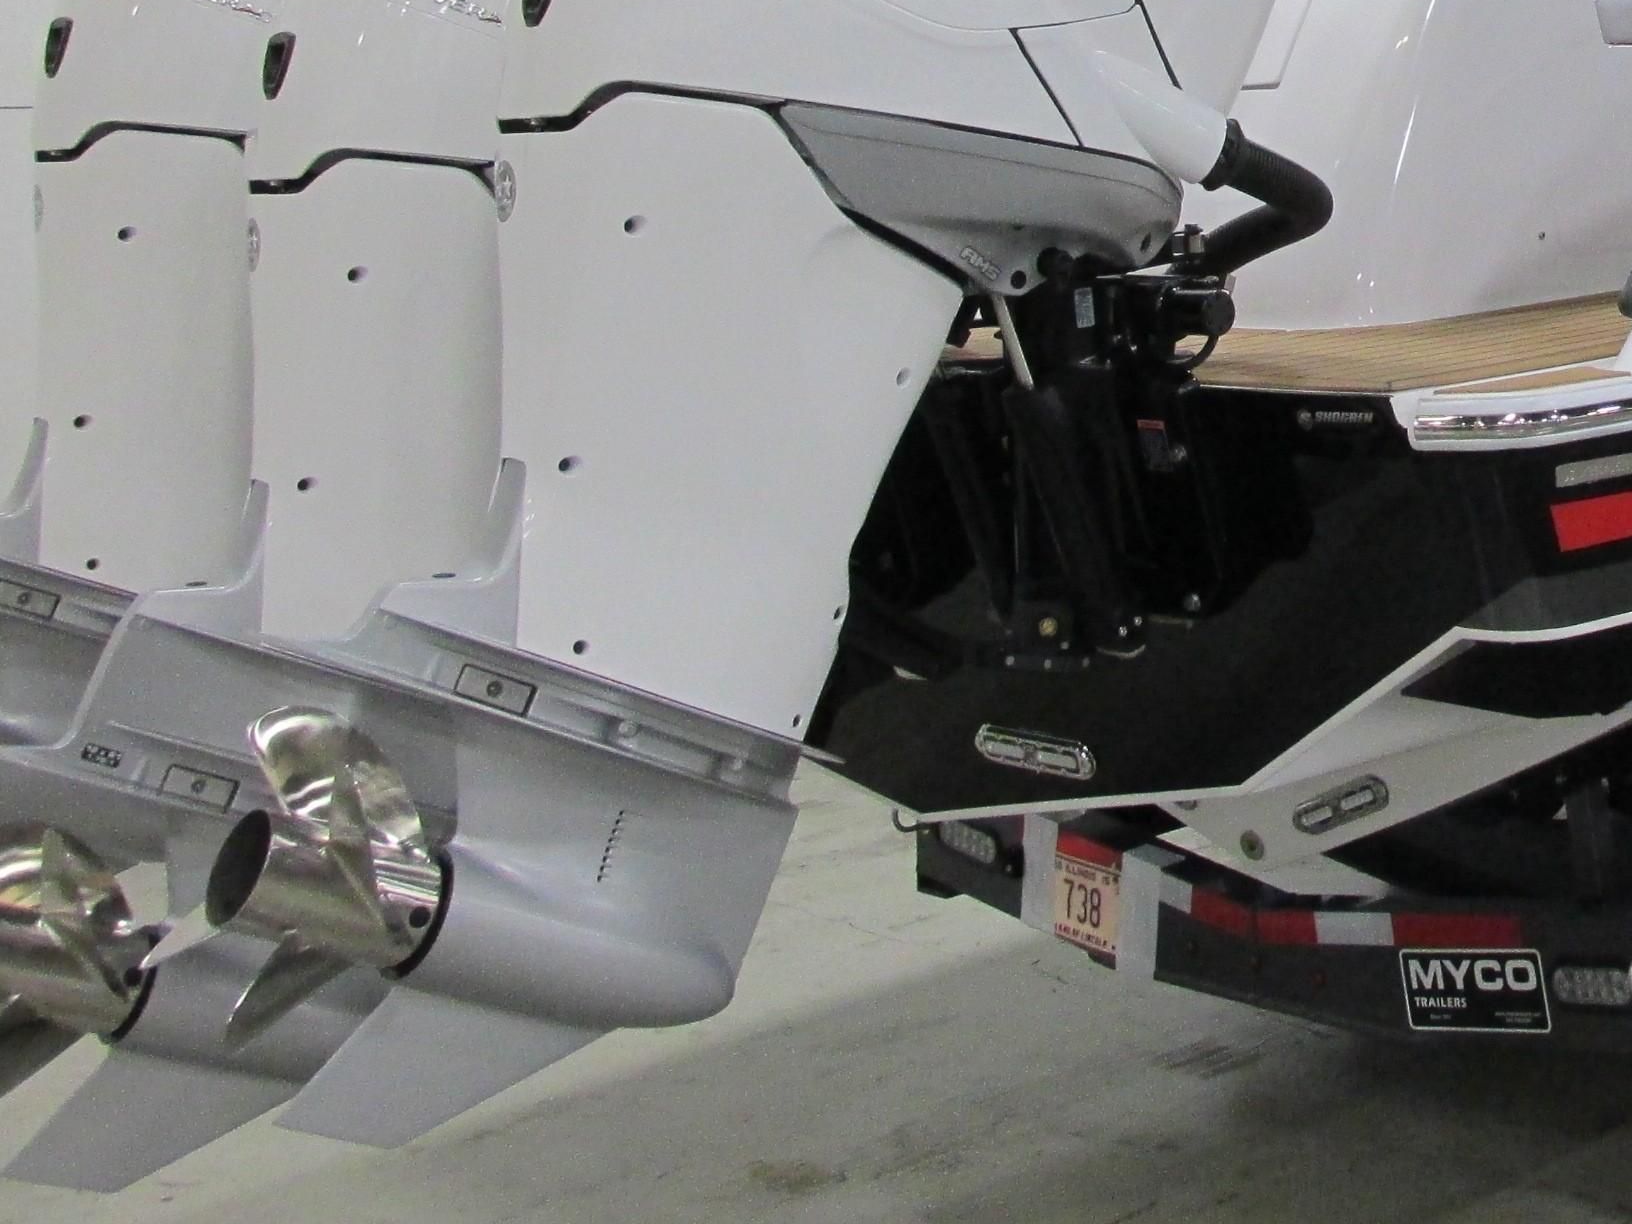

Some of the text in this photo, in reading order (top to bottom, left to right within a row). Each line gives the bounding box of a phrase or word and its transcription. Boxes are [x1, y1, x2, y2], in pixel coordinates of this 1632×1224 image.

[1063, 878, 1102, 929] 738
[1408, 959, 1538, 991] MYCO
[1414, 996, 1468, 1009] TRAILERS
